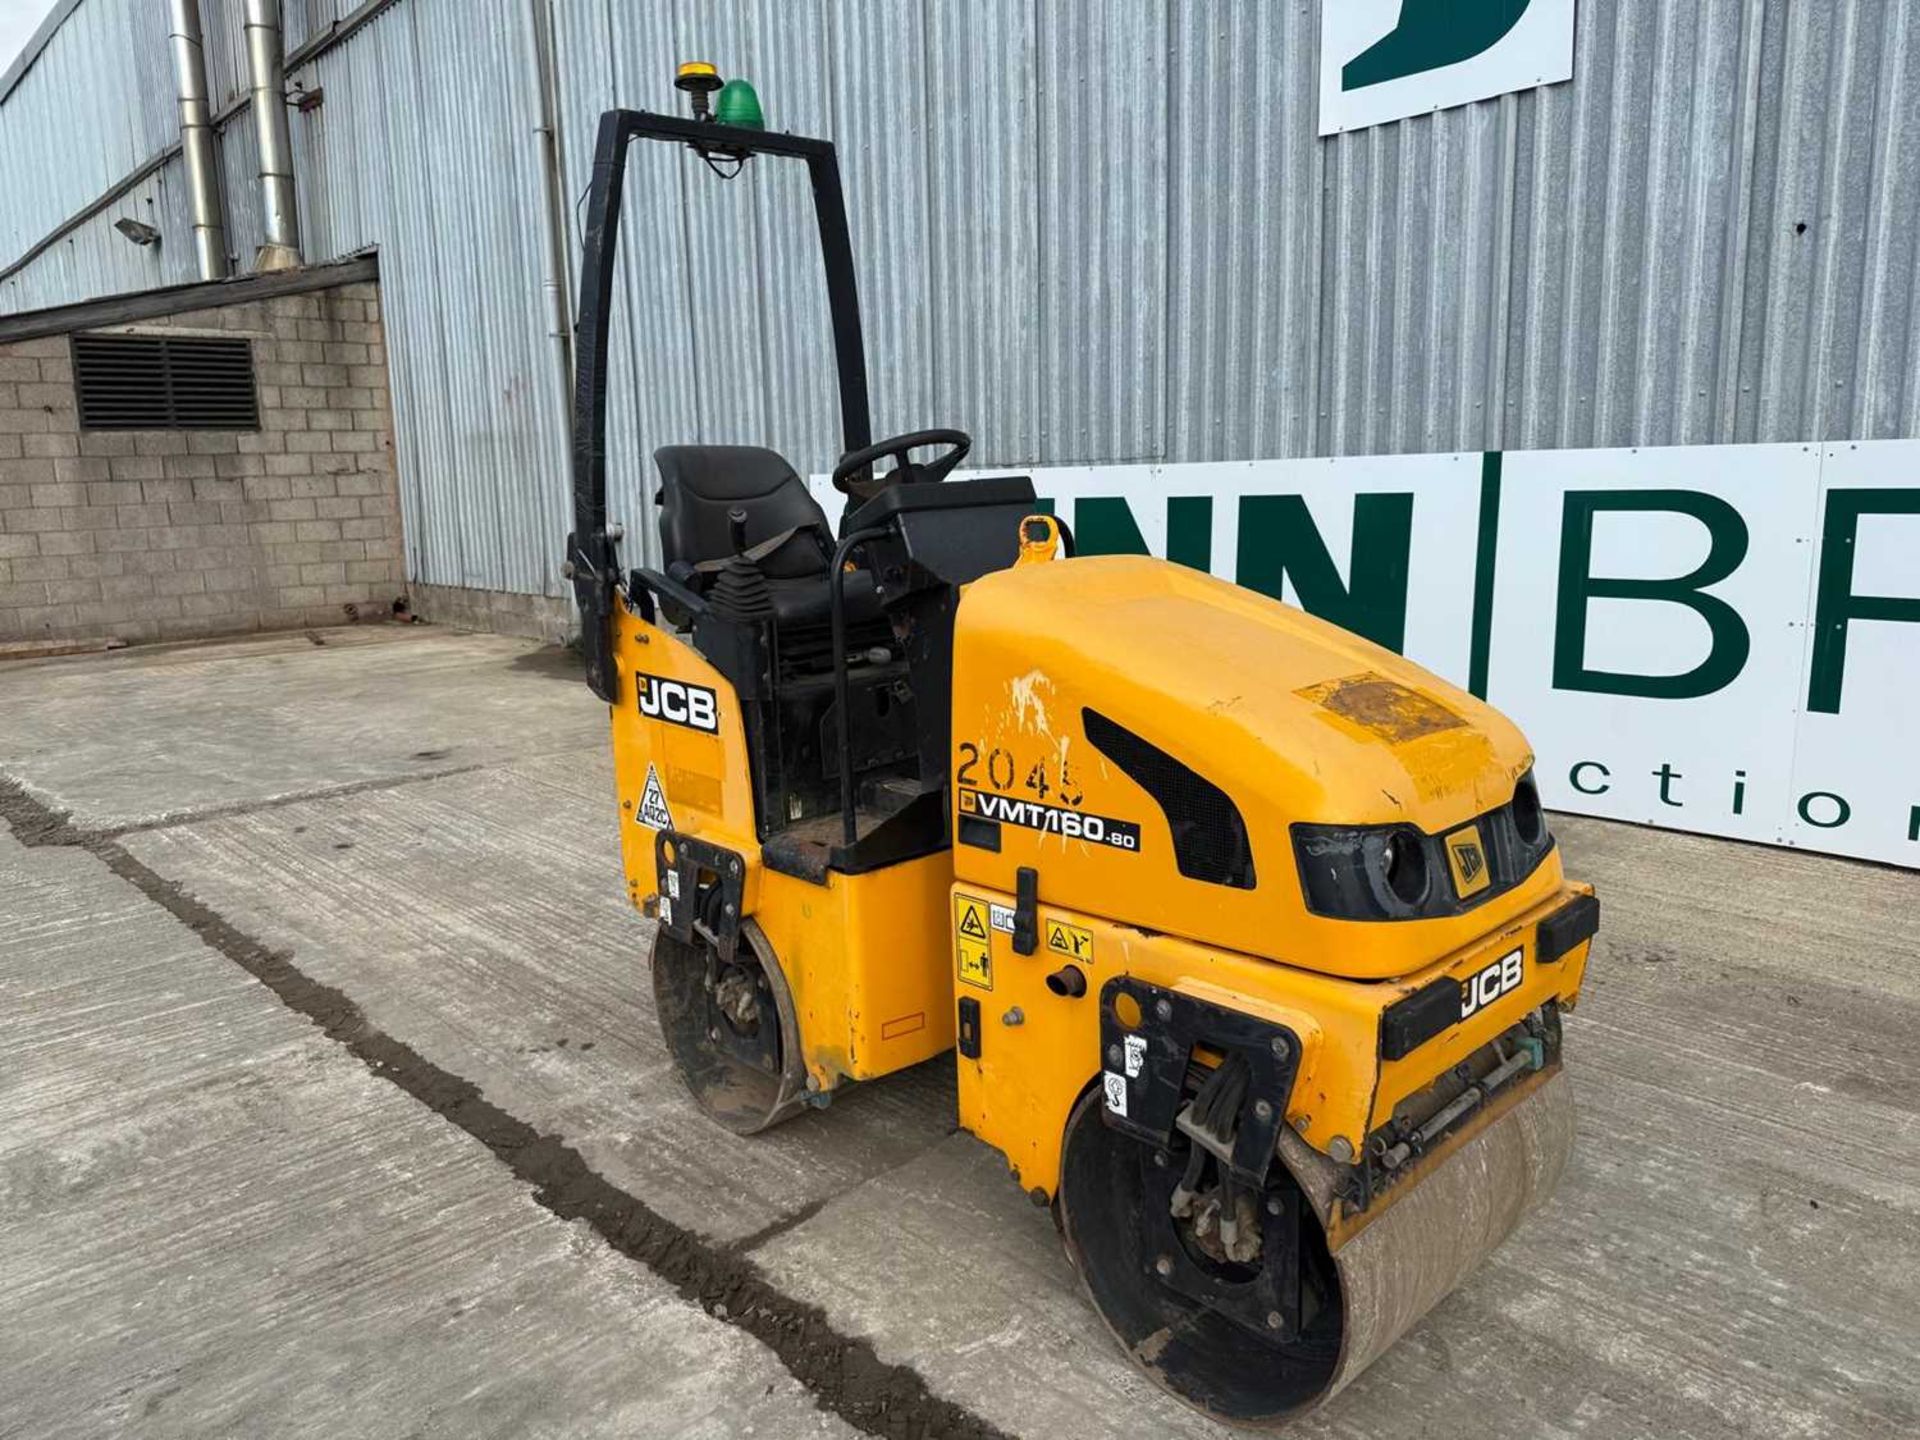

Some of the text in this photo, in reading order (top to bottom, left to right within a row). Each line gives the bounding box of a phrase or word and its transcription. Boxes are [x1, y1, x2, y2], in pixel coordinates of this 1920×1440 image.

[640, 677, 717, 730] JCB
[1569, 761, 1920, 842] ctio
[1461, 949, 1523, 1019] JCB
